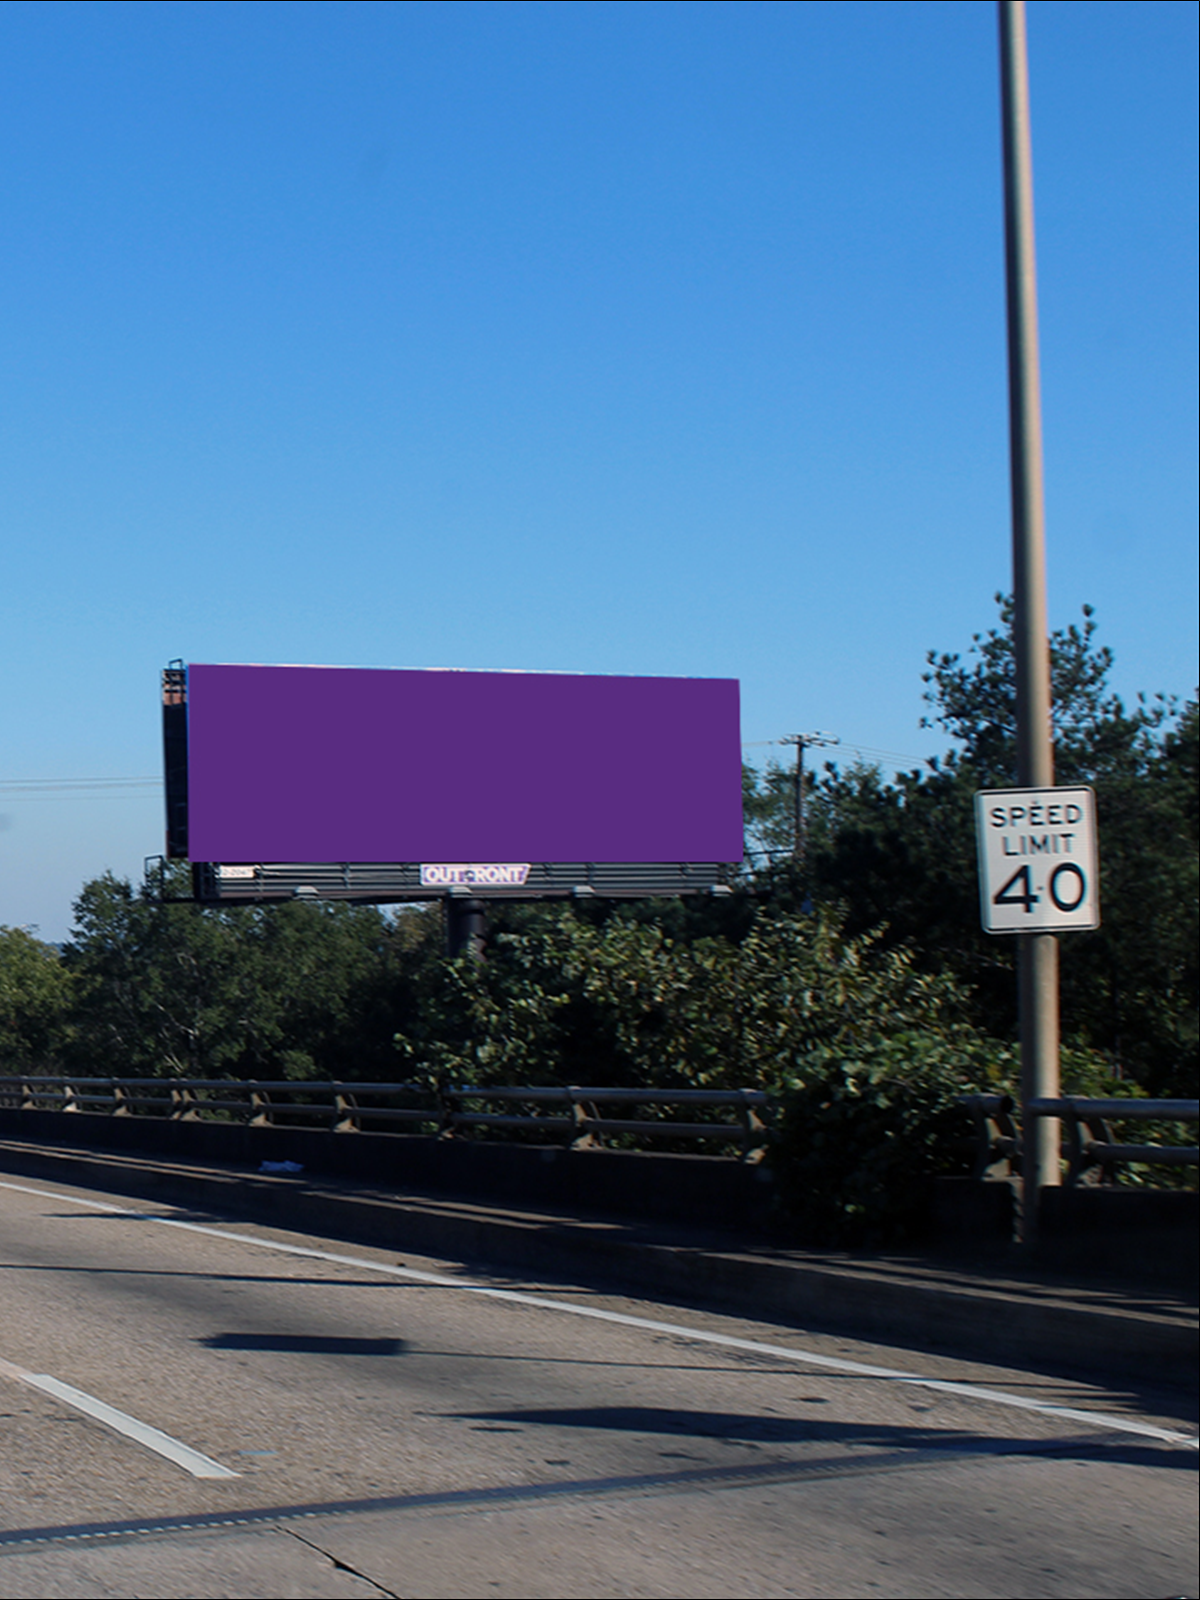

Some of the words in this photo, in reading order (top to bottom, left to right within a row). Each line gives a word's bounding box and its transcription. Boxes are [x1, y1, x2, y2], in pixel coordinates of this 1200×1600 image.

[990, 803, 1082, 828] SPEED
[1002, 833, 1074, 856] LIMIT
[424, 866, 525, 883] OUTRONT
[993, 862, 1087, 913] 40
